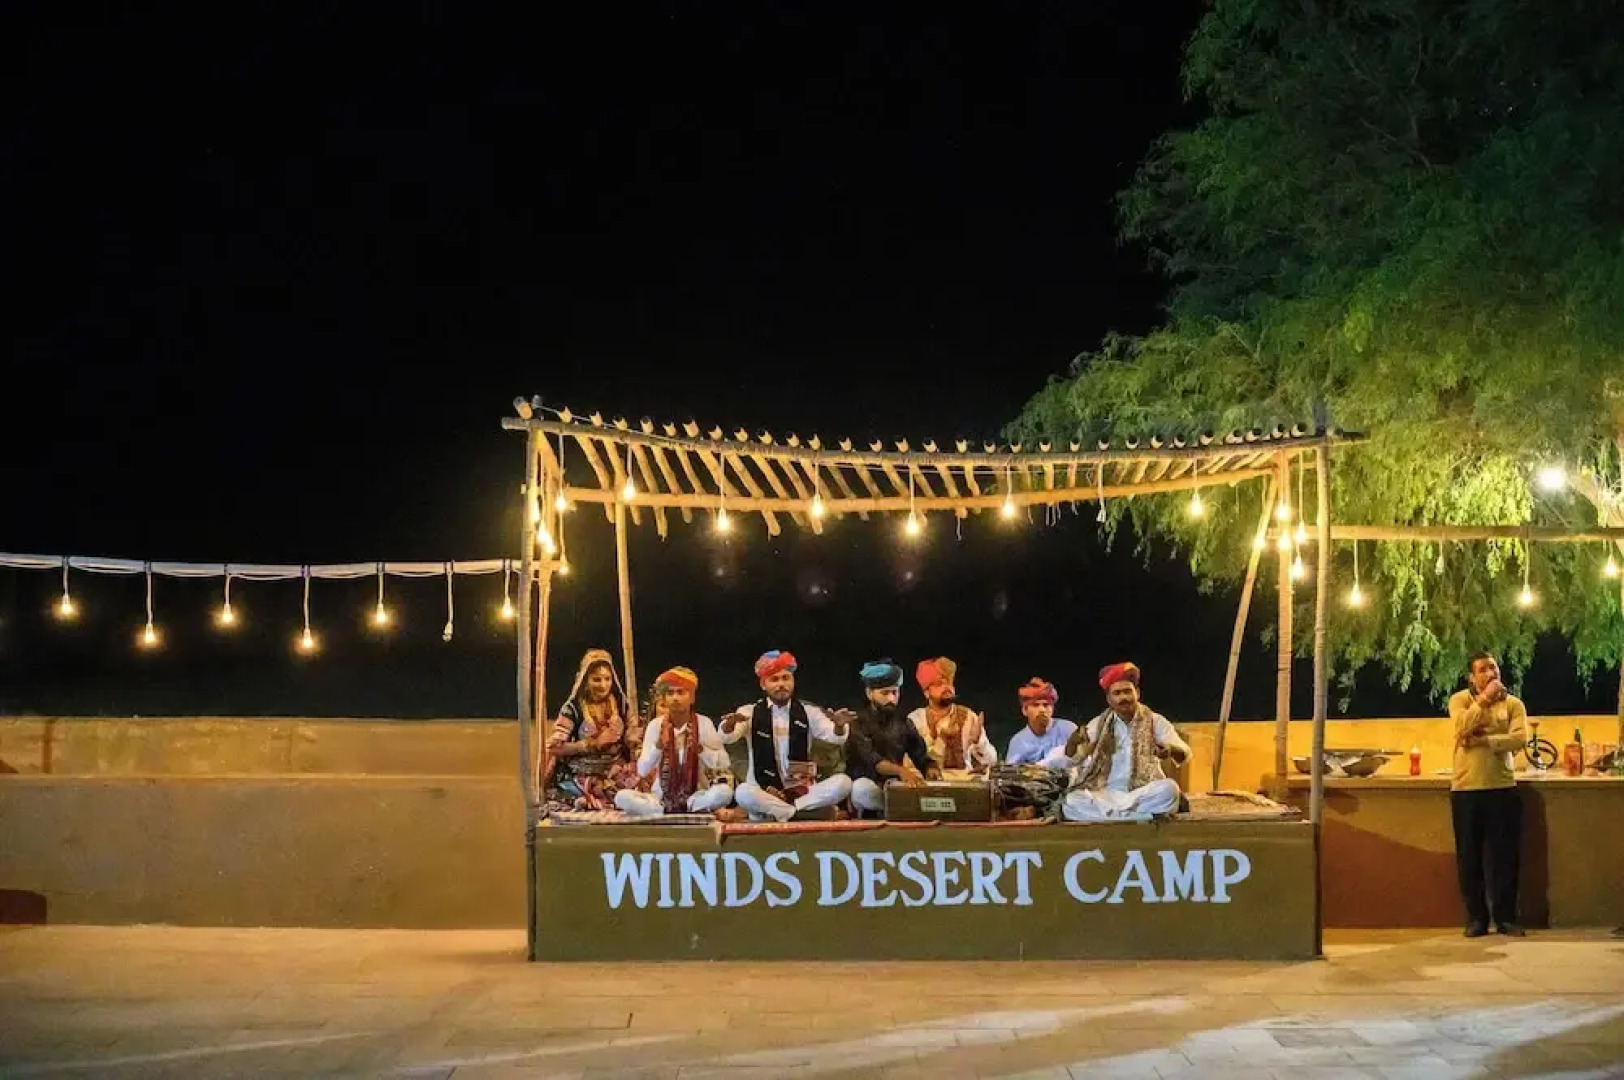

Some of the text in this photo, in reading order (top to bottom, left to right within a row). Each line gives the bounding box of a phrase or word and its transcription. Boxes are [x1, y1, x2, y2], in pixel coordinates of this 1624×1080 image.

[600, 848, 1252, 909] WINDS DESERT CAMP
